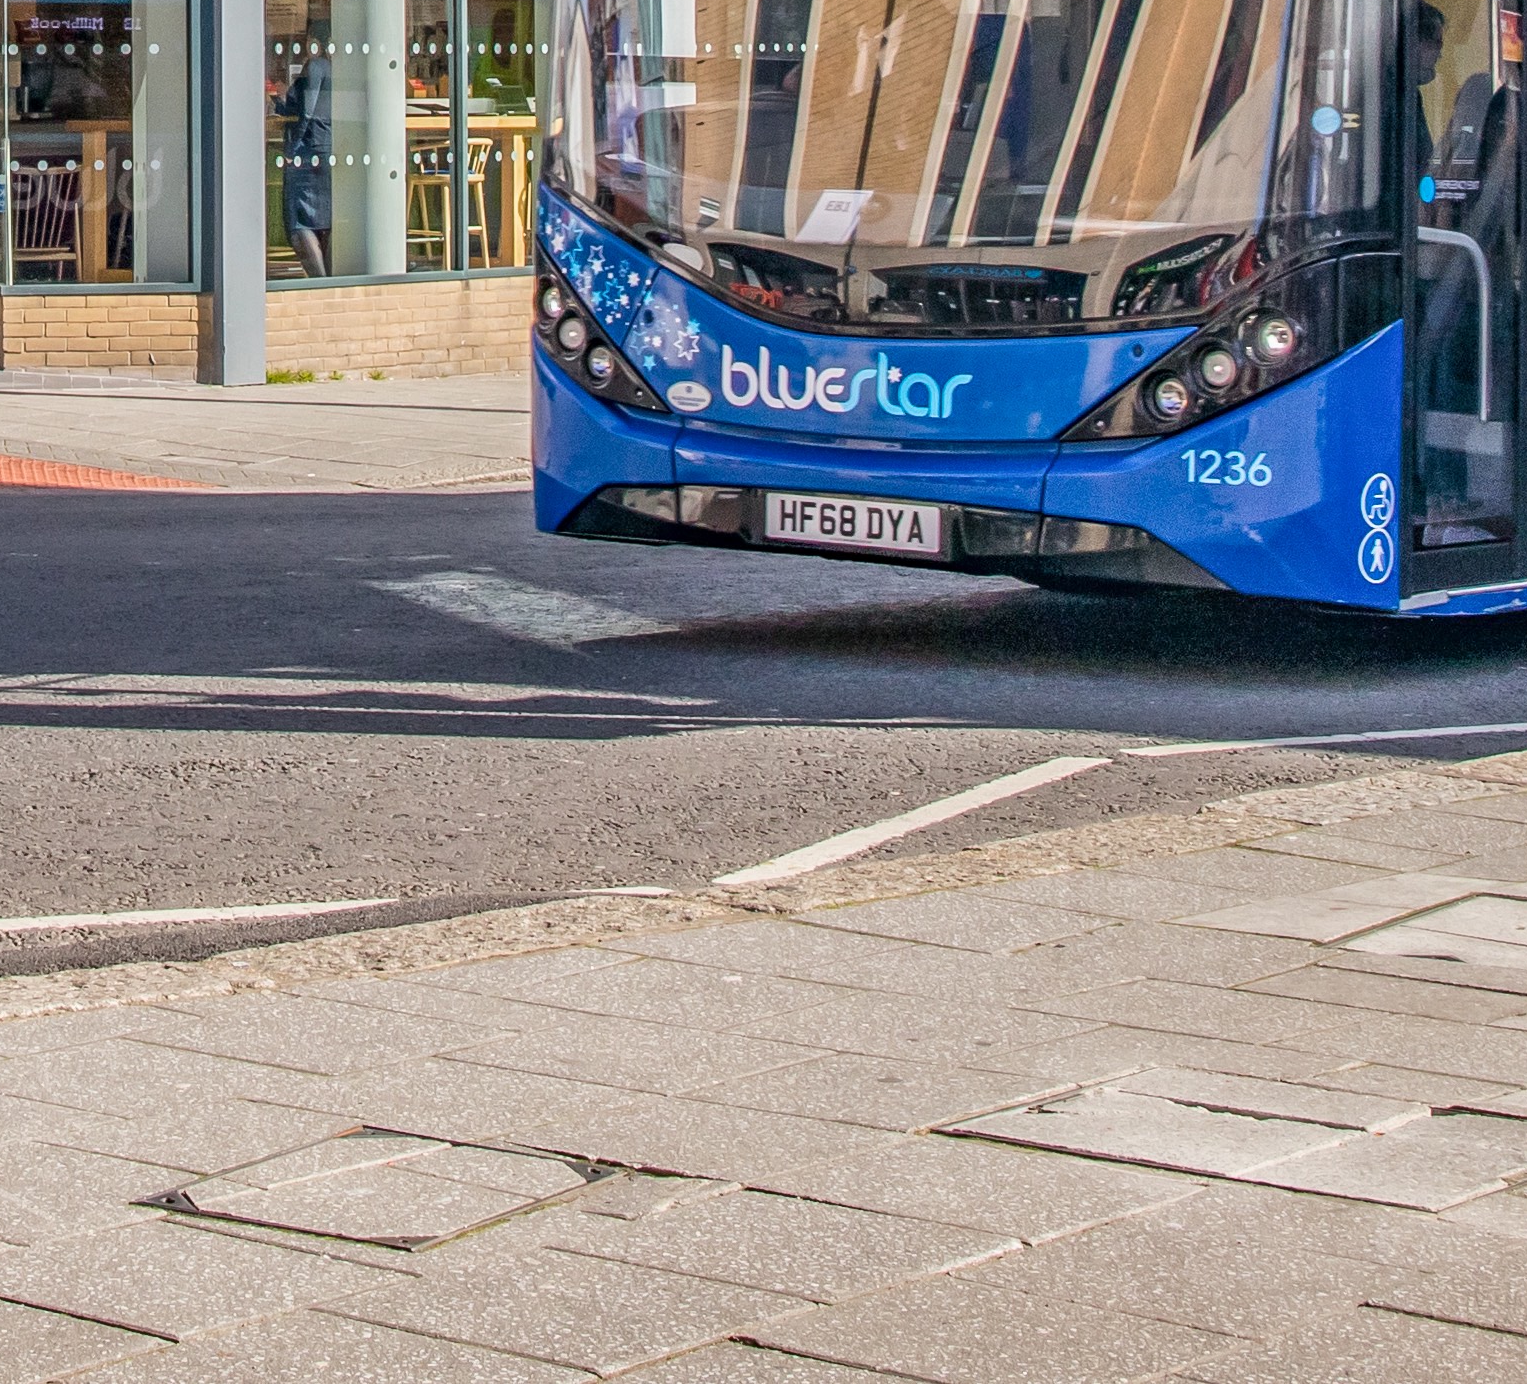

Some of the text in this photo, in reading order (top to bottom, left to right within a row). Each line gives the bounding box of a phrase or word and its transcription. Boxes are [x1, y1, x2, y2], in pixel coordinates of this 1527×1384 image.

[722, 344, 974, 418] bluestar
[1181, 449, 1274, 487] 1236
[780, 499, 924, 544] HF68 DYA
